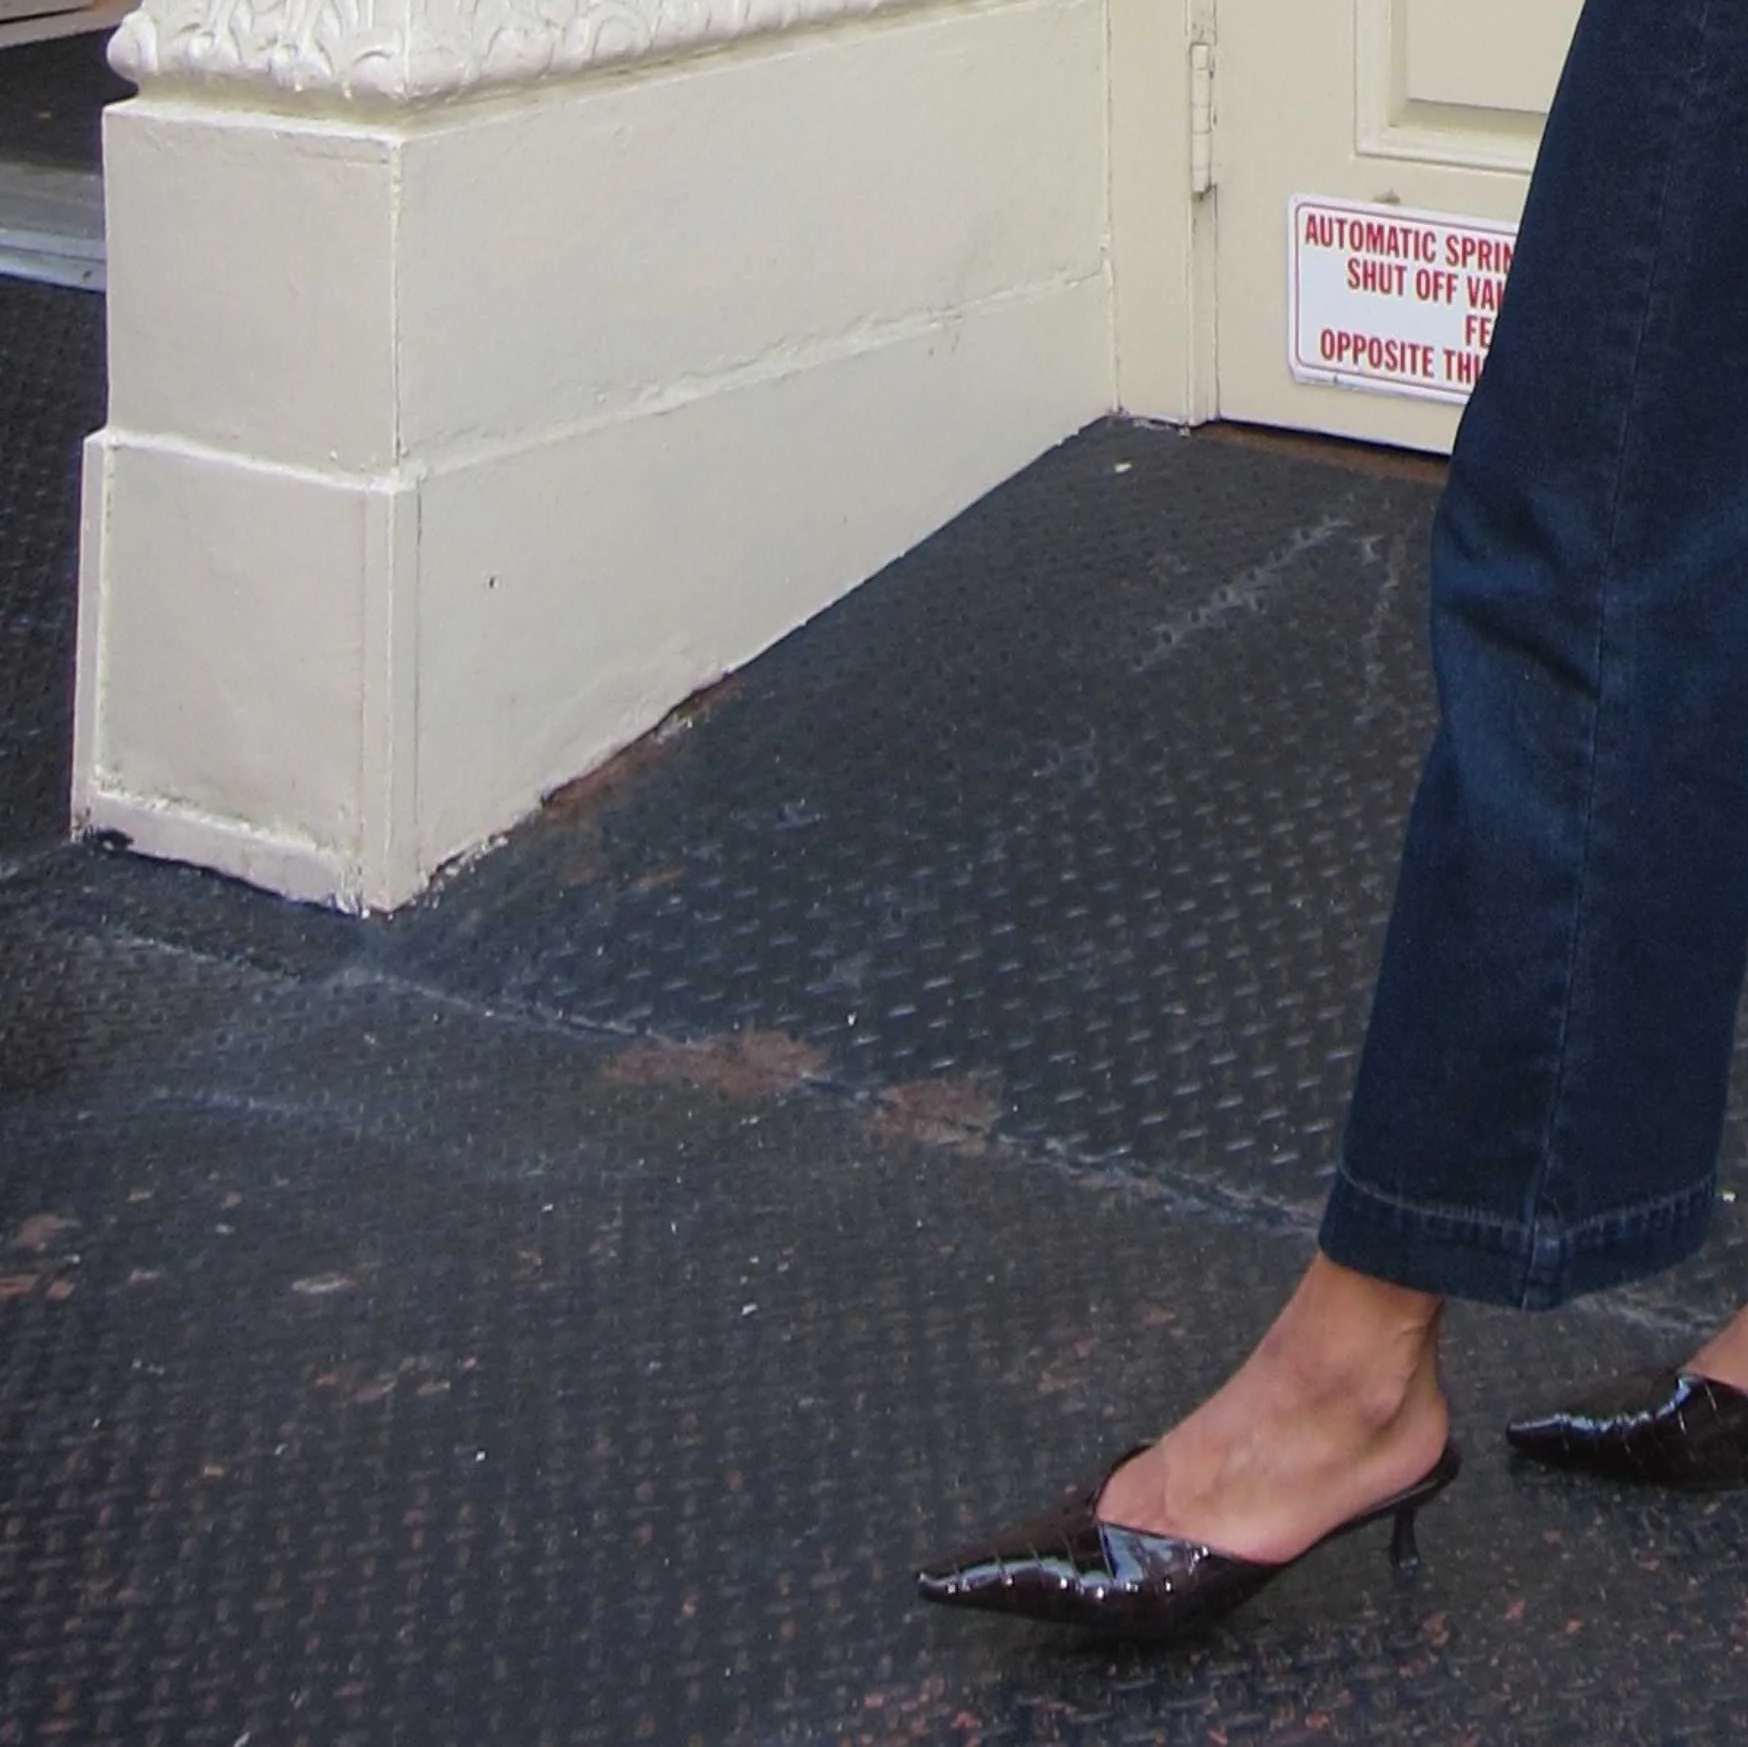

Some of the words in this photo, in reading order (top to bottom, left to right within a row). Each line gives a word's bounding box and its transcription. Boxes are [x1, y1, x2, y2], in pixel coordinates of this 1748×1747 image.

[1305, 213, 1437, 263] AUTOMATIC
[1347, 257, 1408, 297] SHUT
[1416, 268, 1459, 305] OFF
[1321, 328, 1435, 378] OPPOSITE
[1465, 314, 1492, 348] FE
